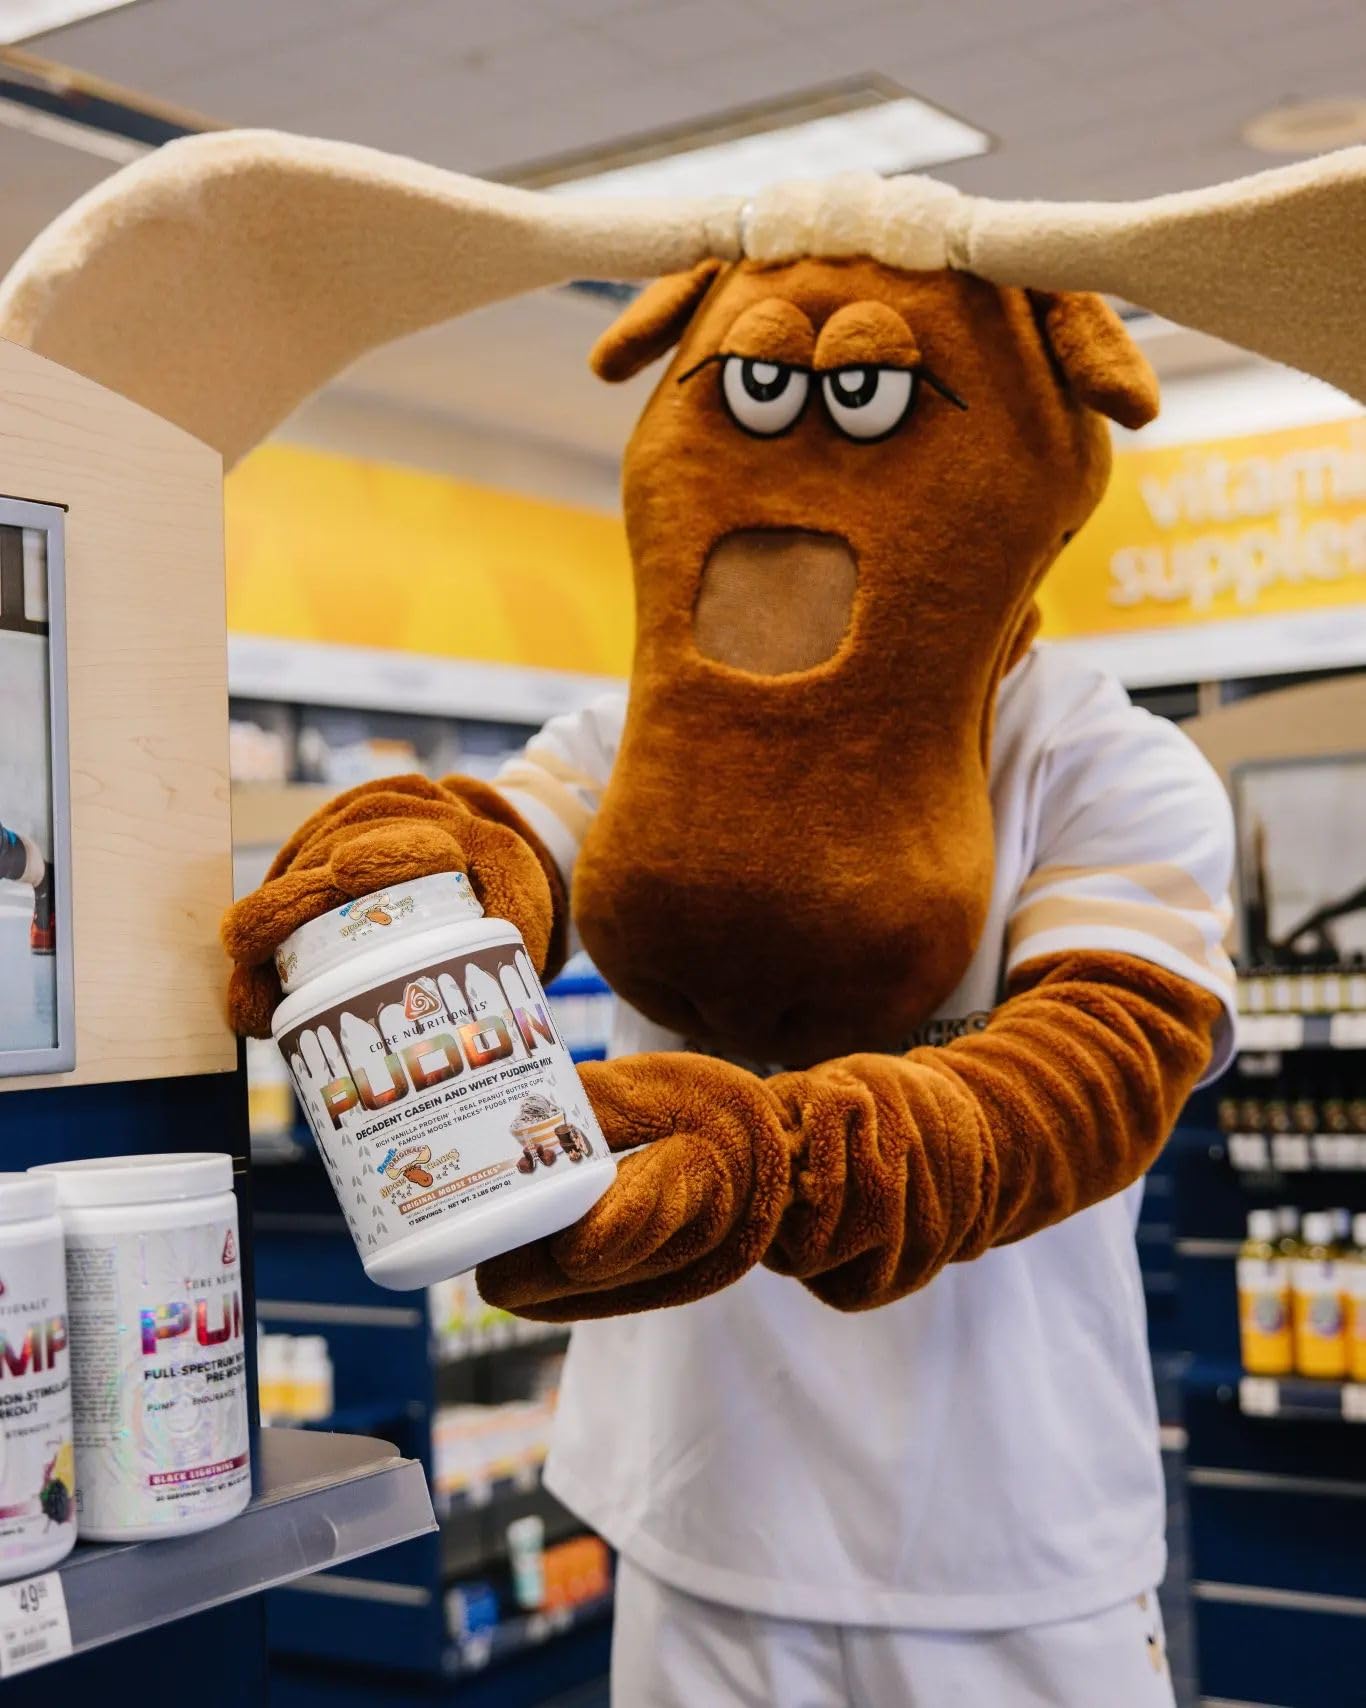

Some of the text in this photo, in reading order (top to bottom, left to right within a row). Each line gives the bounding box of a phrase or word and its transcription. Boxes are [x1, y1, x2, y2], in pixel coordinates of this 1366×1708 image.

[369, 1034, 399, 1053] CORE
[355, 1056, 553, 1141] DECADENT CASEIN AND WHEY PUDDING MIX
[375, 1138, 390, 1149] RICH
[390, 1125, 418, 1141] VANILLA
[459, 1102, 477, 1113] REAL
[478, 1091, 504, 1105] PEANUT
[505, 1082, 529, 1095] BUTTER
[398, 1131, 426, 1147] FAMOUS
[427, 1121, 452, 1134] MOOSE
[484, 1100, 507, 1112] FUDGE
[401, 1166, 499, 1213] ORIGINAL MOOSE TRACKS
[415, 1208, 443, 1224] SERVINGS
[447, 1201, 460, 1210] NET
[477, 1189, 489, 1199] LBS
[152, 1472, 187, 1485] BLACK
